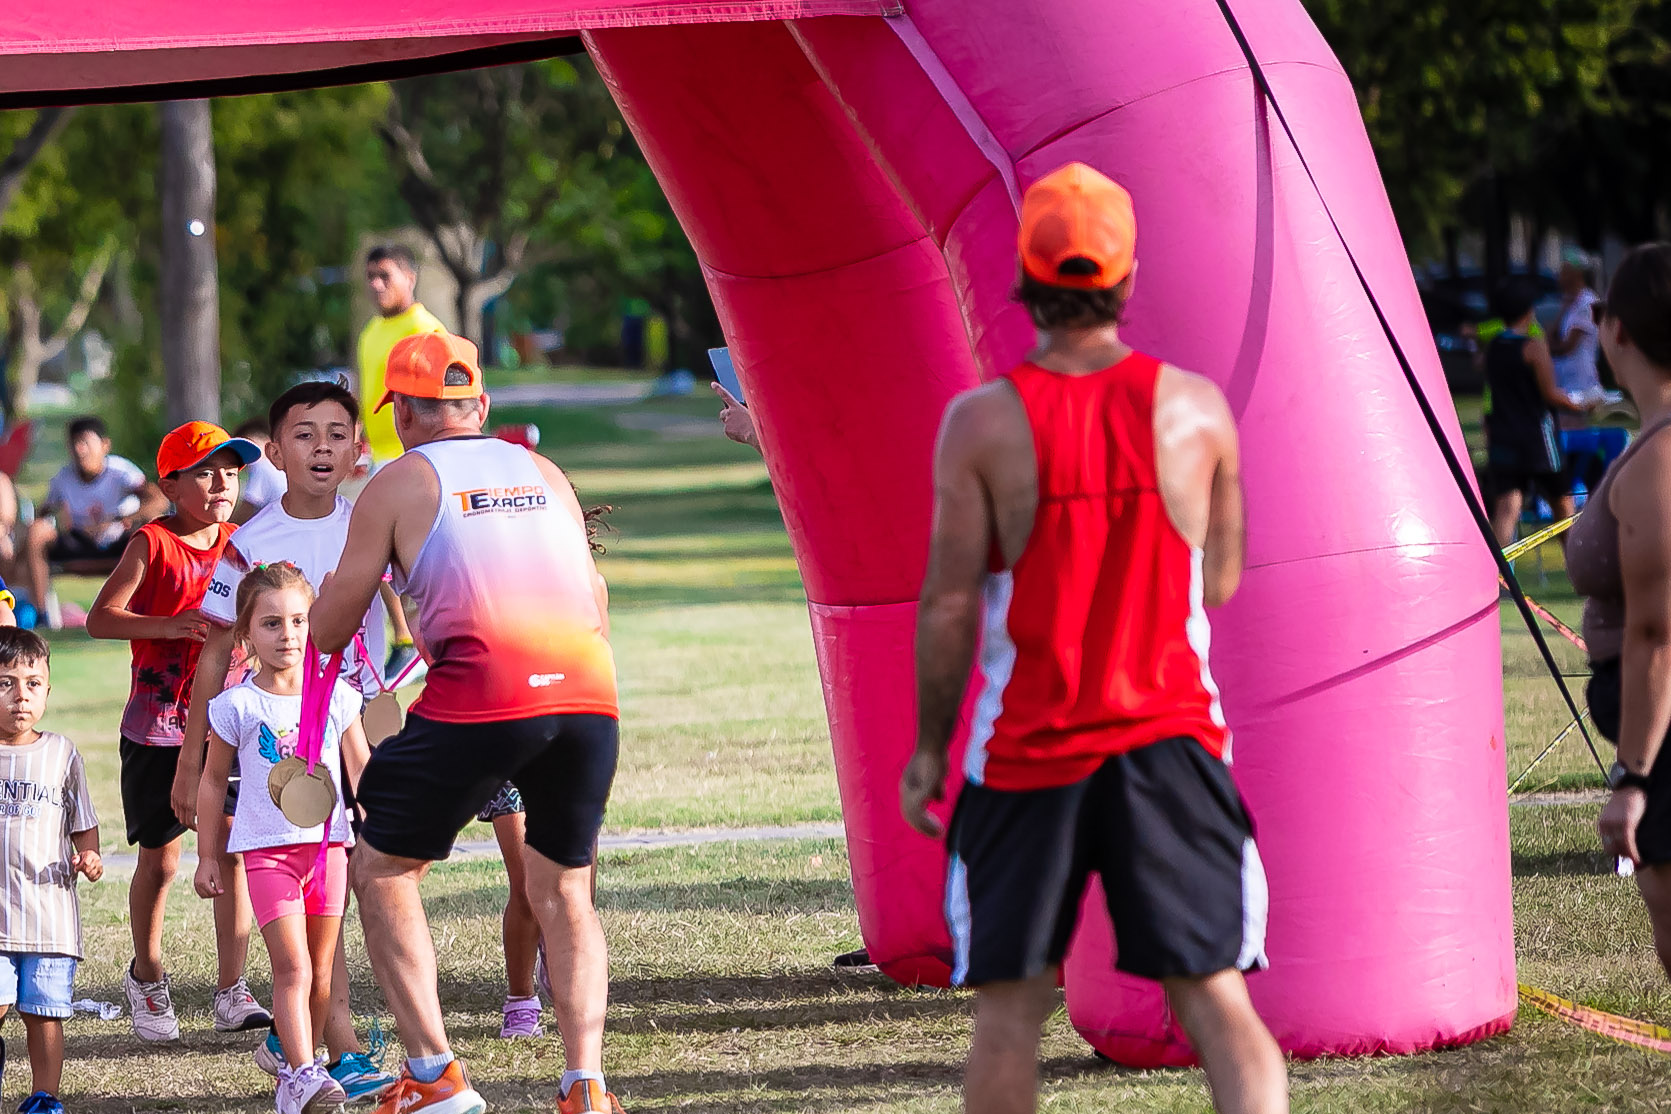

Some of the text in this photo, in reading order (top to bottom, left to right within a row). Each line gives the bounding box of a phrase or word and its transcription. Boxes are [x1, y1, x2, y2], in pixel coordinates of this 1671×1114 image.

[452, 486, 544, 511] TIEMPO
[470, 493, 547, 510] EXACTO
[7, 803, 21, 815] OF
